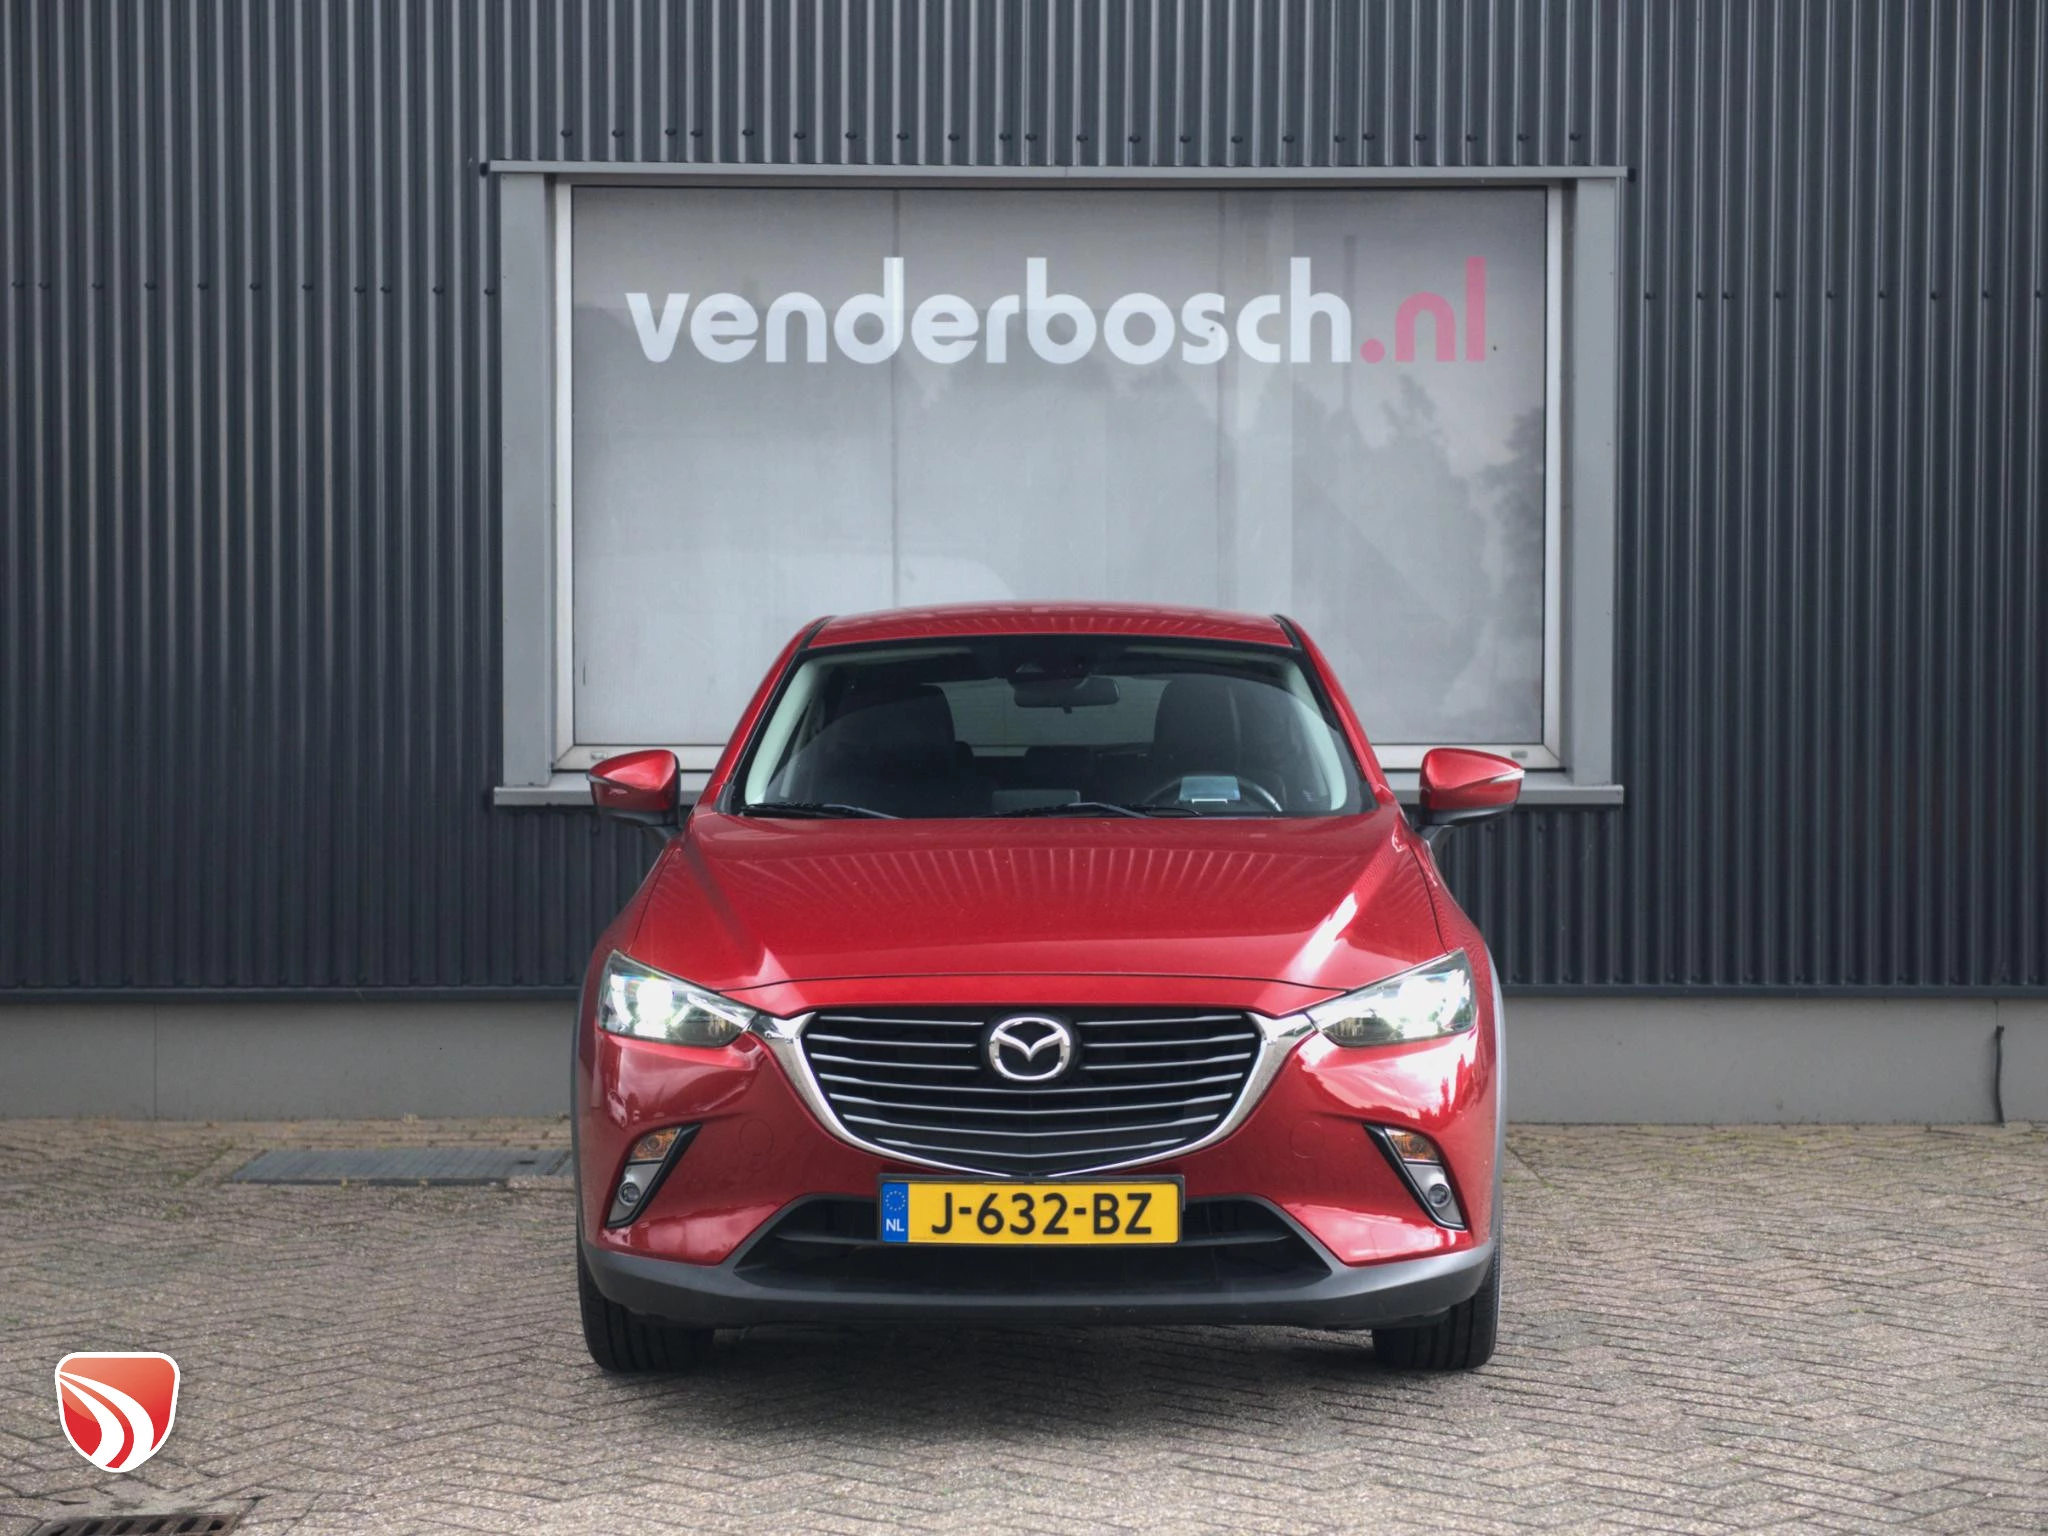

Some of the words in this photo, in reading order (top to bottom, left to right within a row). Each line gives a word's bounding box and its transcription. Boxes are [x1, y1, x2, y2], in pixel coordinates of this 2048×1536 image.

[626, 257, 1486, 364] venderbosch.nl
[885, 1218, 904, 1232] NL
[931, 1192, 1152, 1235] J-632-BZ
